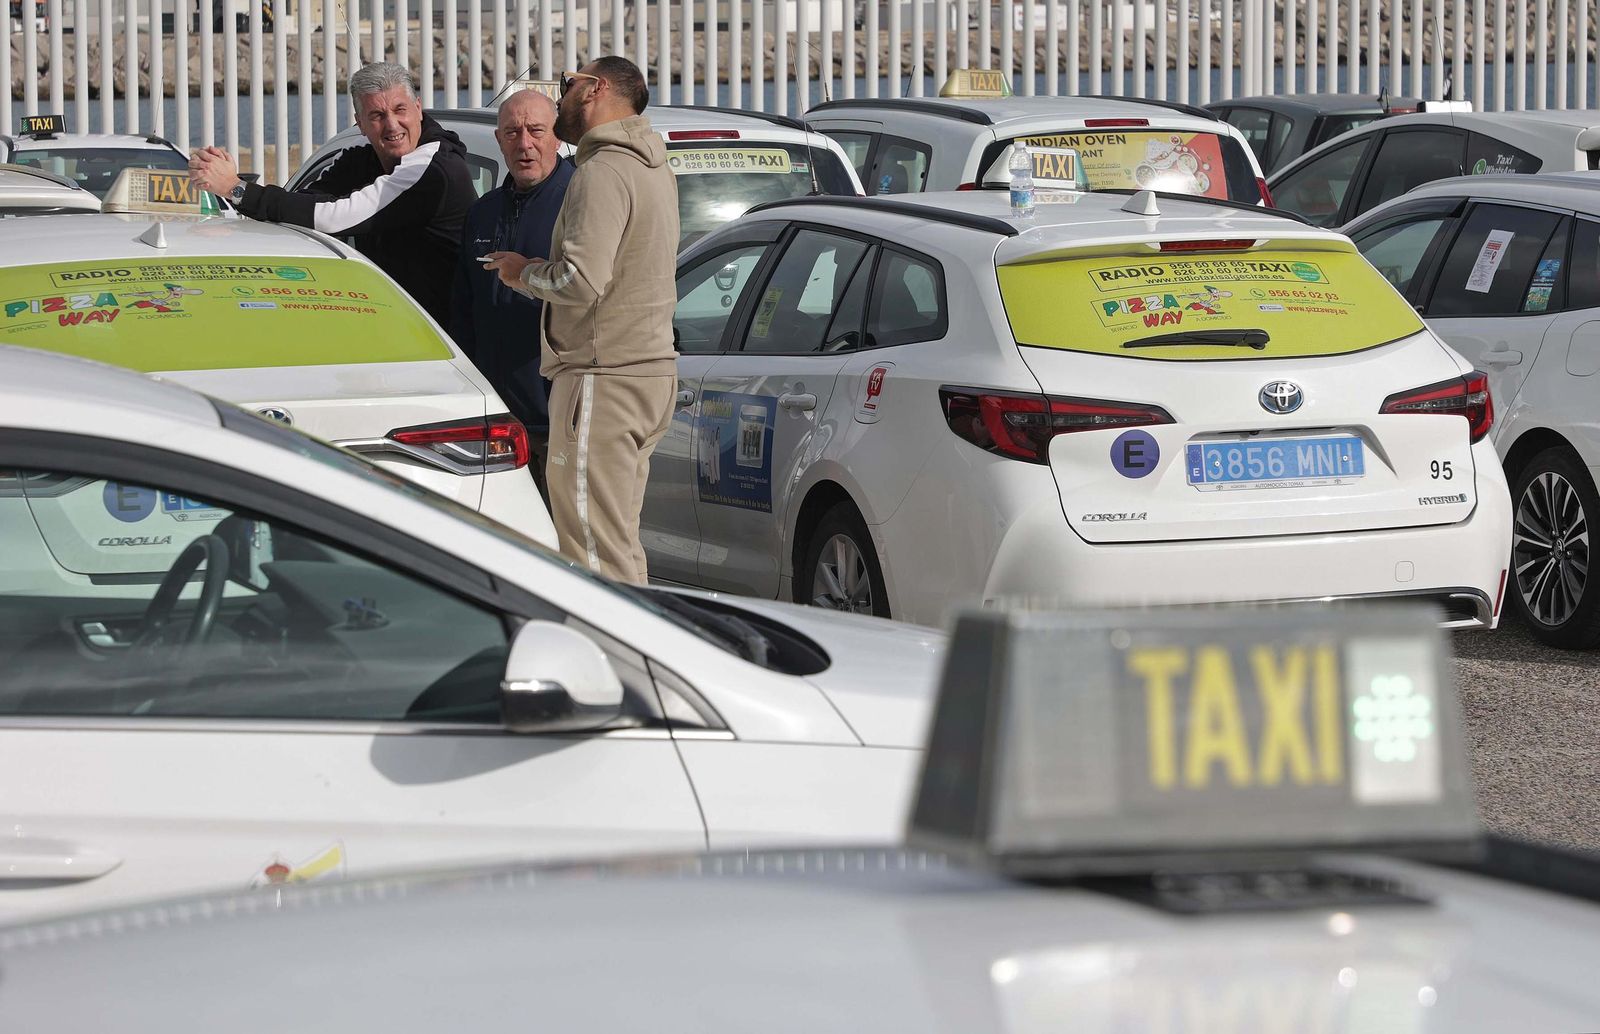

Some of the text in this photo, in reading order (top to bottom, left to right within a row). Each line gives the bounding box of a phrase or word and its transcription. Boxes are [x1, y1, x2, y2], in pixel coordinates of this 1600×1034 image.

[970, 72, 1000, 90] TAXI
[30, 118, 54, 130] TAXI
[1025, 134, 1126, 147] INDIAN OVEN
[747, 155, 784, 166] TAXI
[1496, 154, 1514, 164] Taxi
[1034, 154, 1072, 178] TAXI
[1099, 266, 1164, 281] RADIO
[1246, 263, 1292, 273] TAXI
[62, 269, 131, 281] RADIO
[1146, 274, 1284, 284] www.radiotaxisalgeciras.es
[348, 291, 369, 300] 03
[5, 292, 118, 317] PIZZA
[282, 303, 377, 314] www.pizzaway.es
[1102, 294, 1180, 316] PIZZA
[58, 308, 120, 326] WAY
[1143, 311, 1182, 328] WAY
[873, 372, 882, 381] YA
[1124, 440, 1145, 468] E
[1193, 444, 1354, 480] E 3856 MNH
[1431, 460, 1453, 480] 95
[1418, 495, 1460, 505] HYBRID
[1082, 512, 1147, 522] COROLLA
[98, 536, 172, 546] COROLLA
[1127, 645, 1343, 789] TAXI
